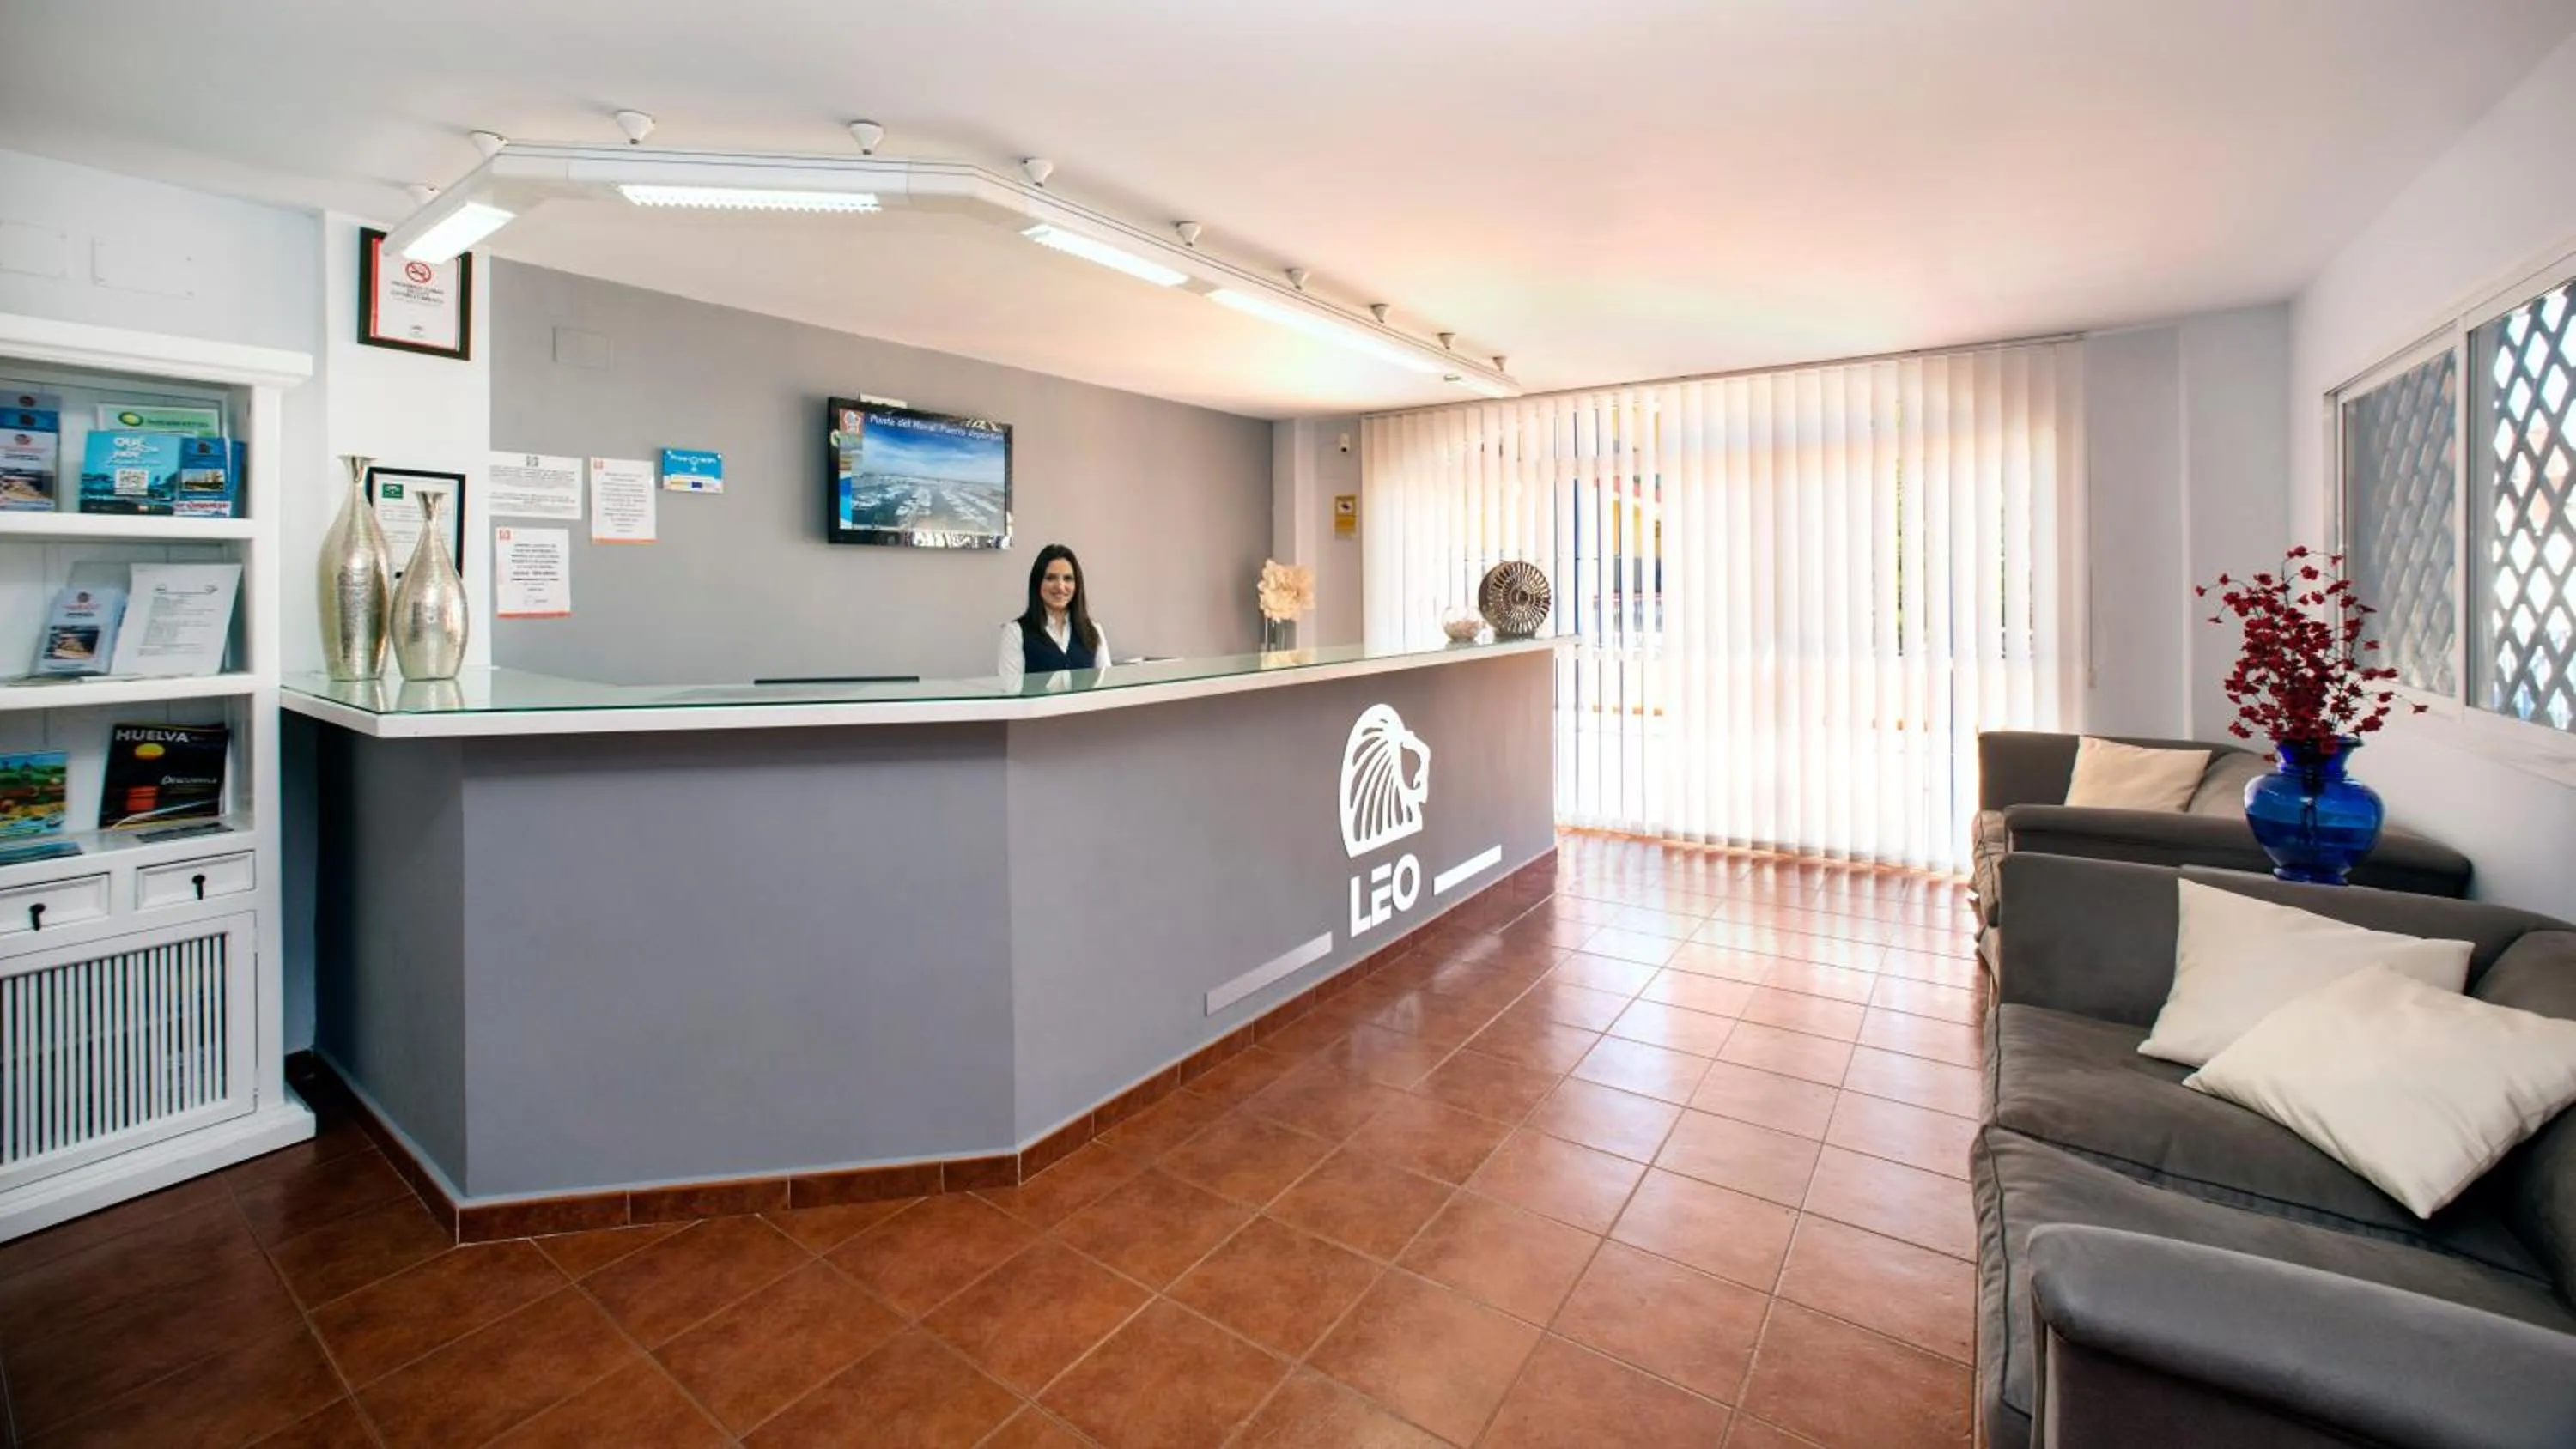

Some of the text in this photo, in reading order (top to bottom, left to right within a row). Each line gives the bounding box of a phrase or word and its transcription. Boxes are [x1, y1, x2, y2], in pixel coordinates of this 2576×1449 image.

[870, 414, 895, 427] Punta
[897, 418, 911, 427] del
[115, 729, 190, 743] HUELVA
[1350, 853, 1421, 938] LEO
